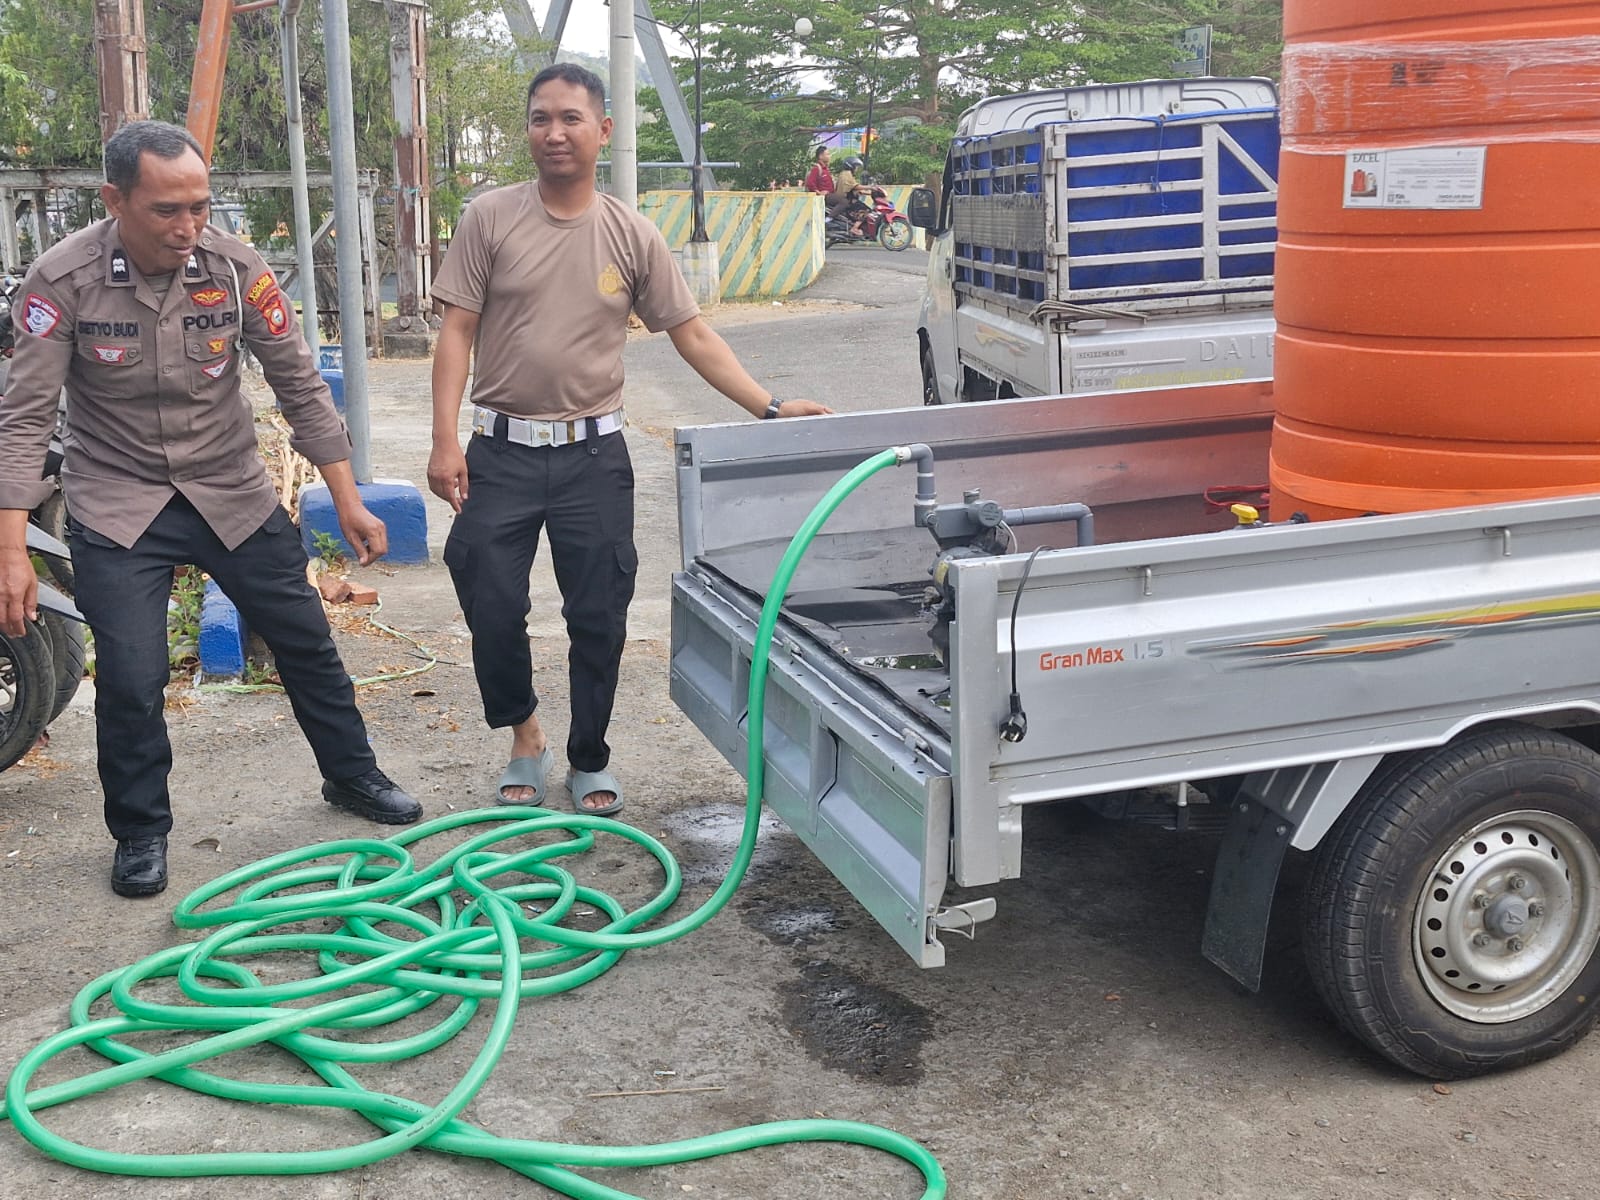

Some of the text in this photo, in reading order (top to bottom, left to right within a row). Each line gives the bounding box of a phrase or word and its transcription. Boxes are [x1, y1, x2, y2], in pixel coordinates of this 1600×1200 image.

[183, 309, 237, 331] POLRI
[1039, 652, 1083, 671] Gran
[1086, 646, 1125, 666] Max
